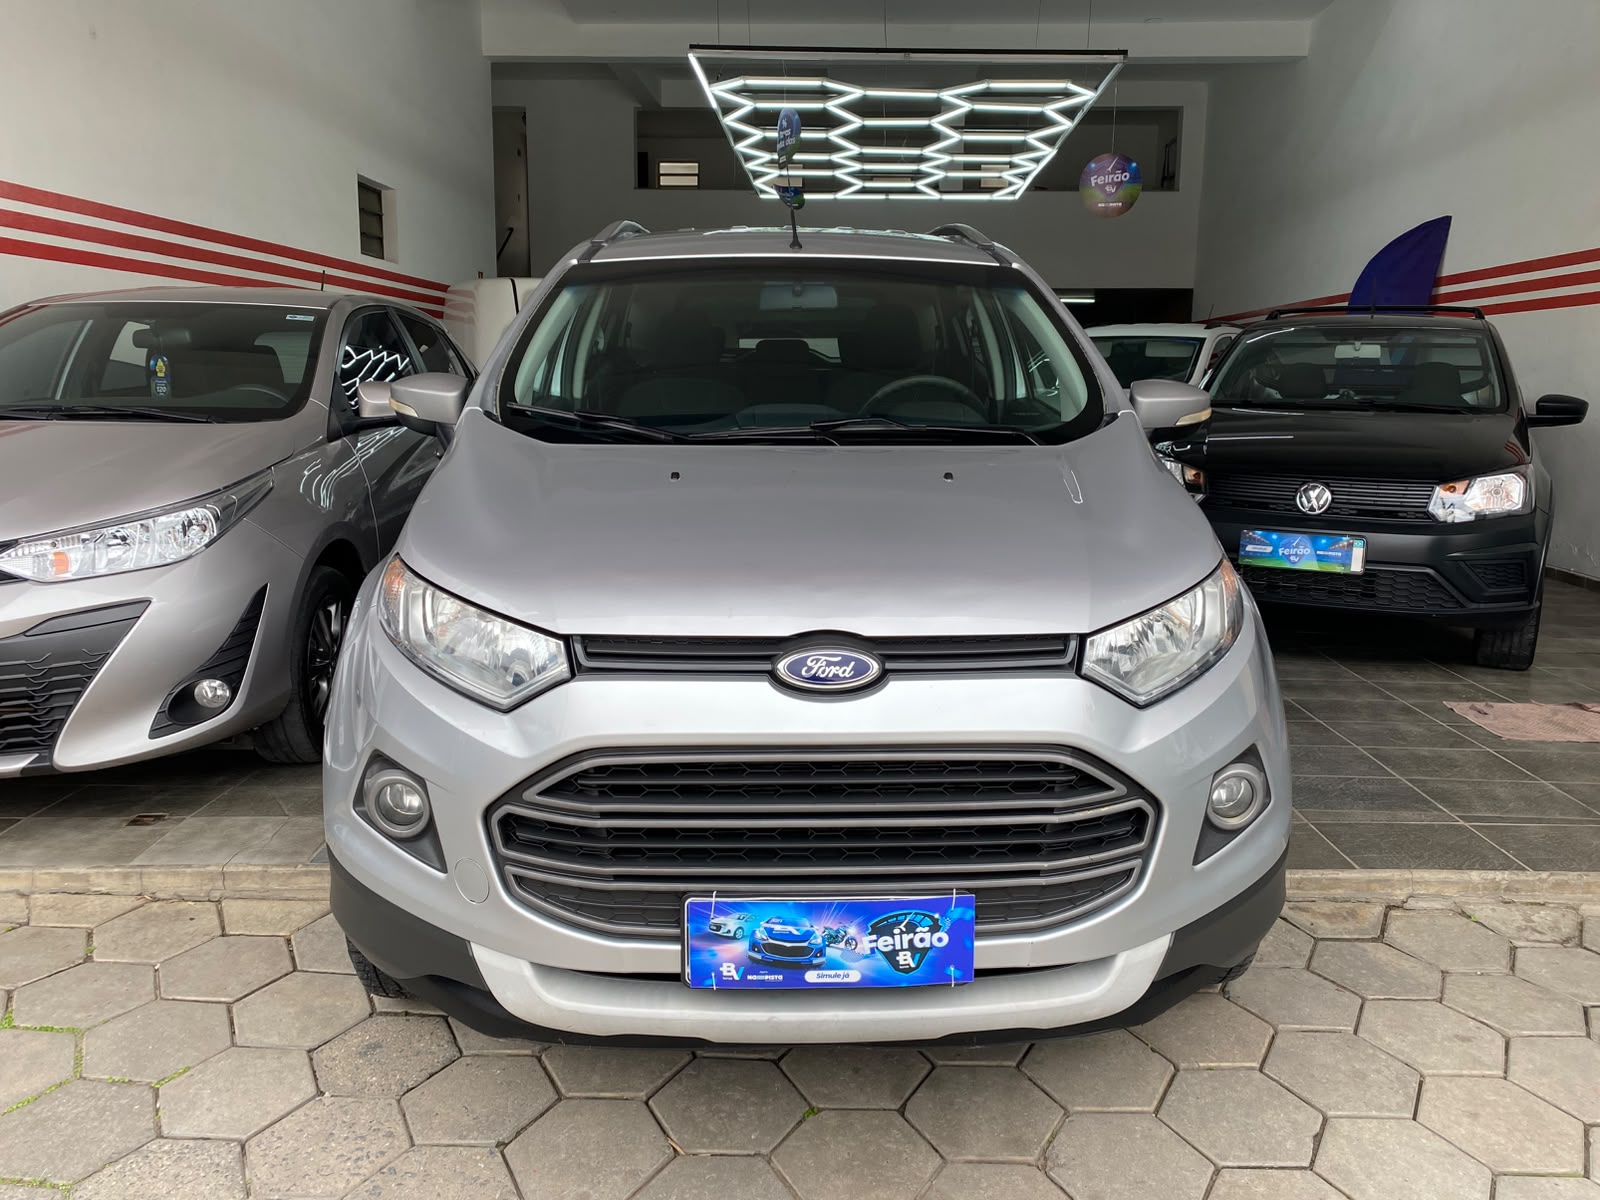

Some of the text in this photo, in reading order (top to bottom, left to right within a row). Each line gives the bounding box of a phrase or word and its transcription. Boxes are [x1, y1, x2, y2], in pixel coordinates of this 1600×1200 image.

[1090, 170, 1130, 187] Feirão
[1278, 545, 1311, 556] Feirão
[801, 655, 855, 678] Ford
[861, 927, 949, 955] Feirão
[842, 972, 850, 980] já
